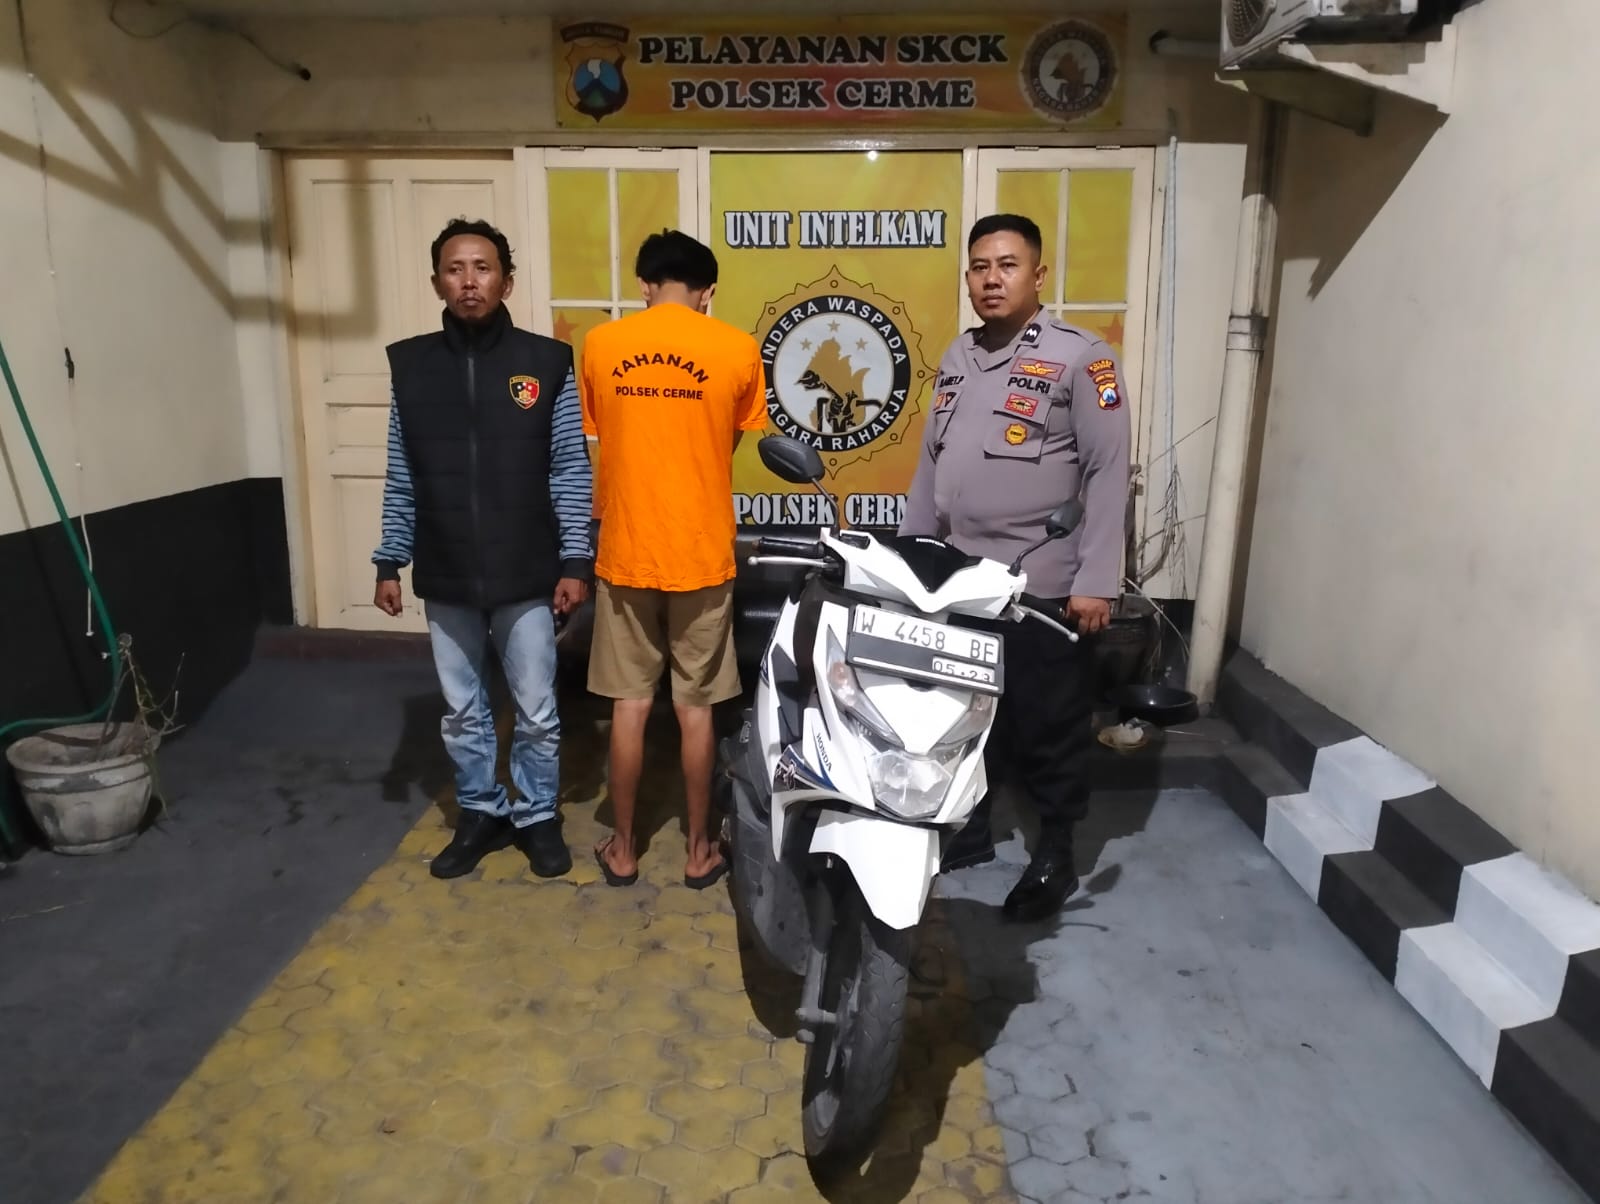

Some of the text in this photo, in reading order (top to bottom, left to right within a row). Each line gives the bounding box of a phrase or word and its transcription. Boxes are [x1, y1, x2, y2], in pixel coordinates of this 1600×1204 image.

[639, 35, 888, 65] PELAYANAN
[896, 34, 1009, 64] SKCK
[670, 79, 976, 109] POLSEK CERME
[724, 210, 947, 248] UNIT INTELKAM
[762, 297, 907, 365] INDERA WASPADA
[611, 352, 709, 385] TAHANAN
[615, 386, 703, 400] POLSEK CERME
[1008, 377, 1050, 394] POLRI
[764, 387, 907, 451] NAGARA RAHARJA
[732, 493, 837, 526] POLSEK
[861, 612, 876, 633] W
[894, 621, 947, 651] 4458
[815, 732, 833, 772] HONDA
